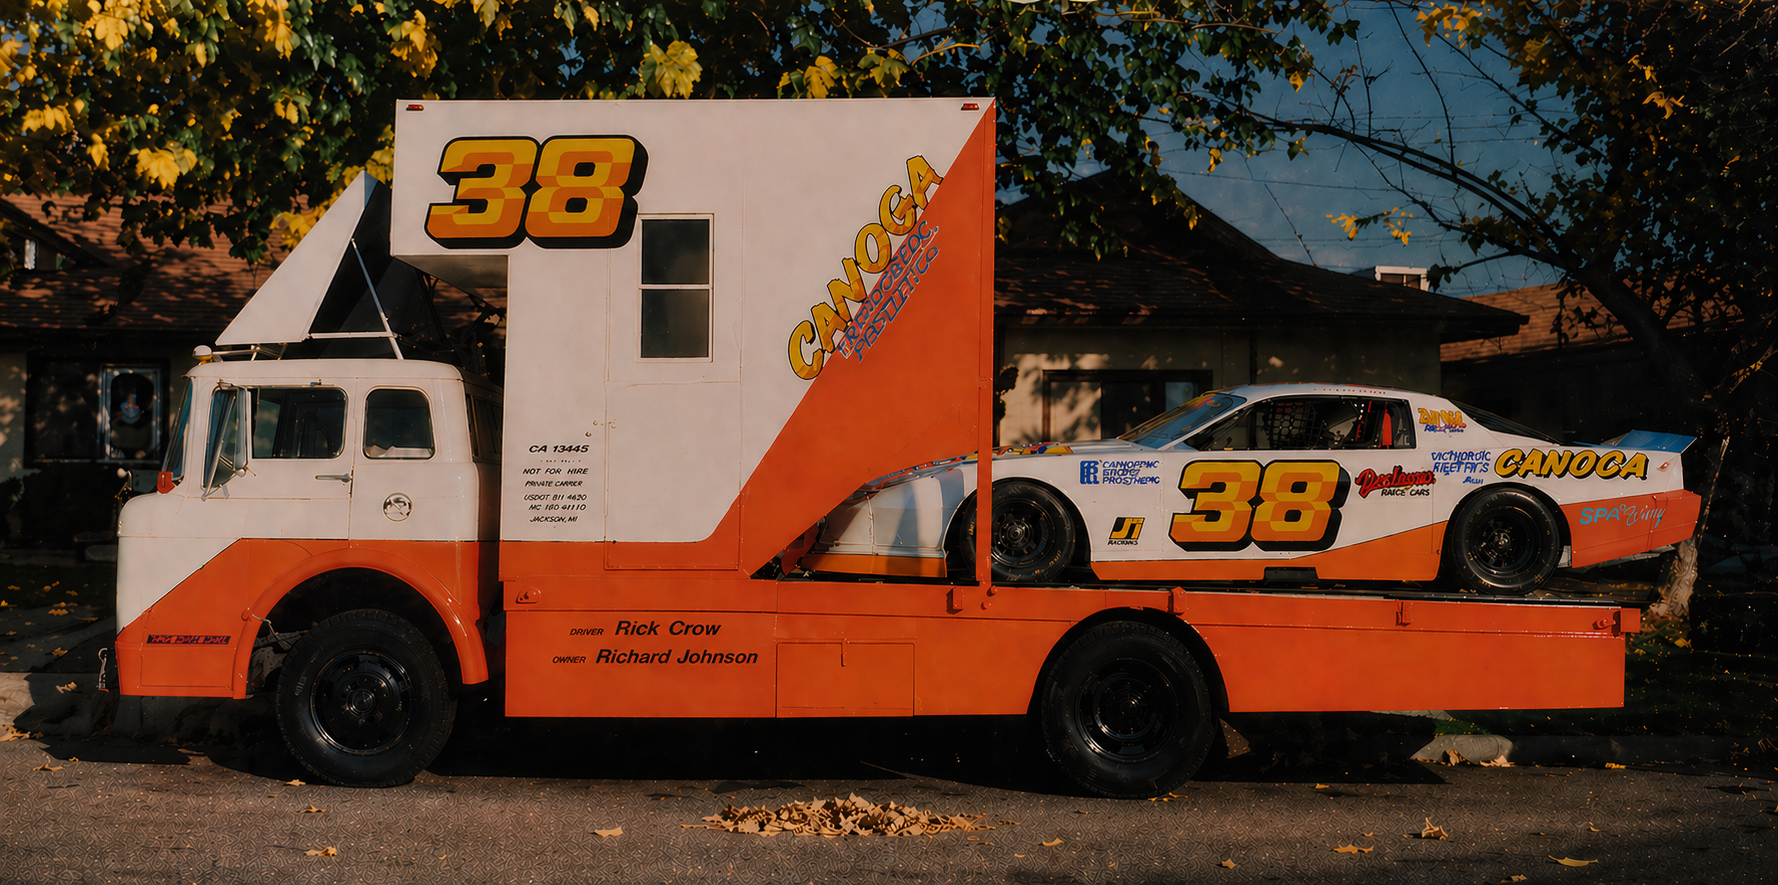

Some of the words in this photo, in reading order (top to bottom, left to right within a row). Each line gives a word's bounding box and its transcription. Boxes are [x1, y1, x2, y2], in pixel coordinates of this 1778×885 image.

[426, 135, 648, 249] 38
[788, 155, 943, 380] CANOGA
[529, 445, 548, 453] CA
[553, 444, 590, 453] 13445
[1409, 488, 1430, 496] CARS
[1168, 459, 1350, 551] 38
[1579, 507, 1620, 525] SPA
[569, 628, 604, 636] DRIVER
[615, 620, 660, 636] Rick
[669, 620, 721, 636] Crow
[552, 656, 586, 664] OWNER
[596, 649, 672, 664] Richard
[677, 649, 758, 664] Johnson
